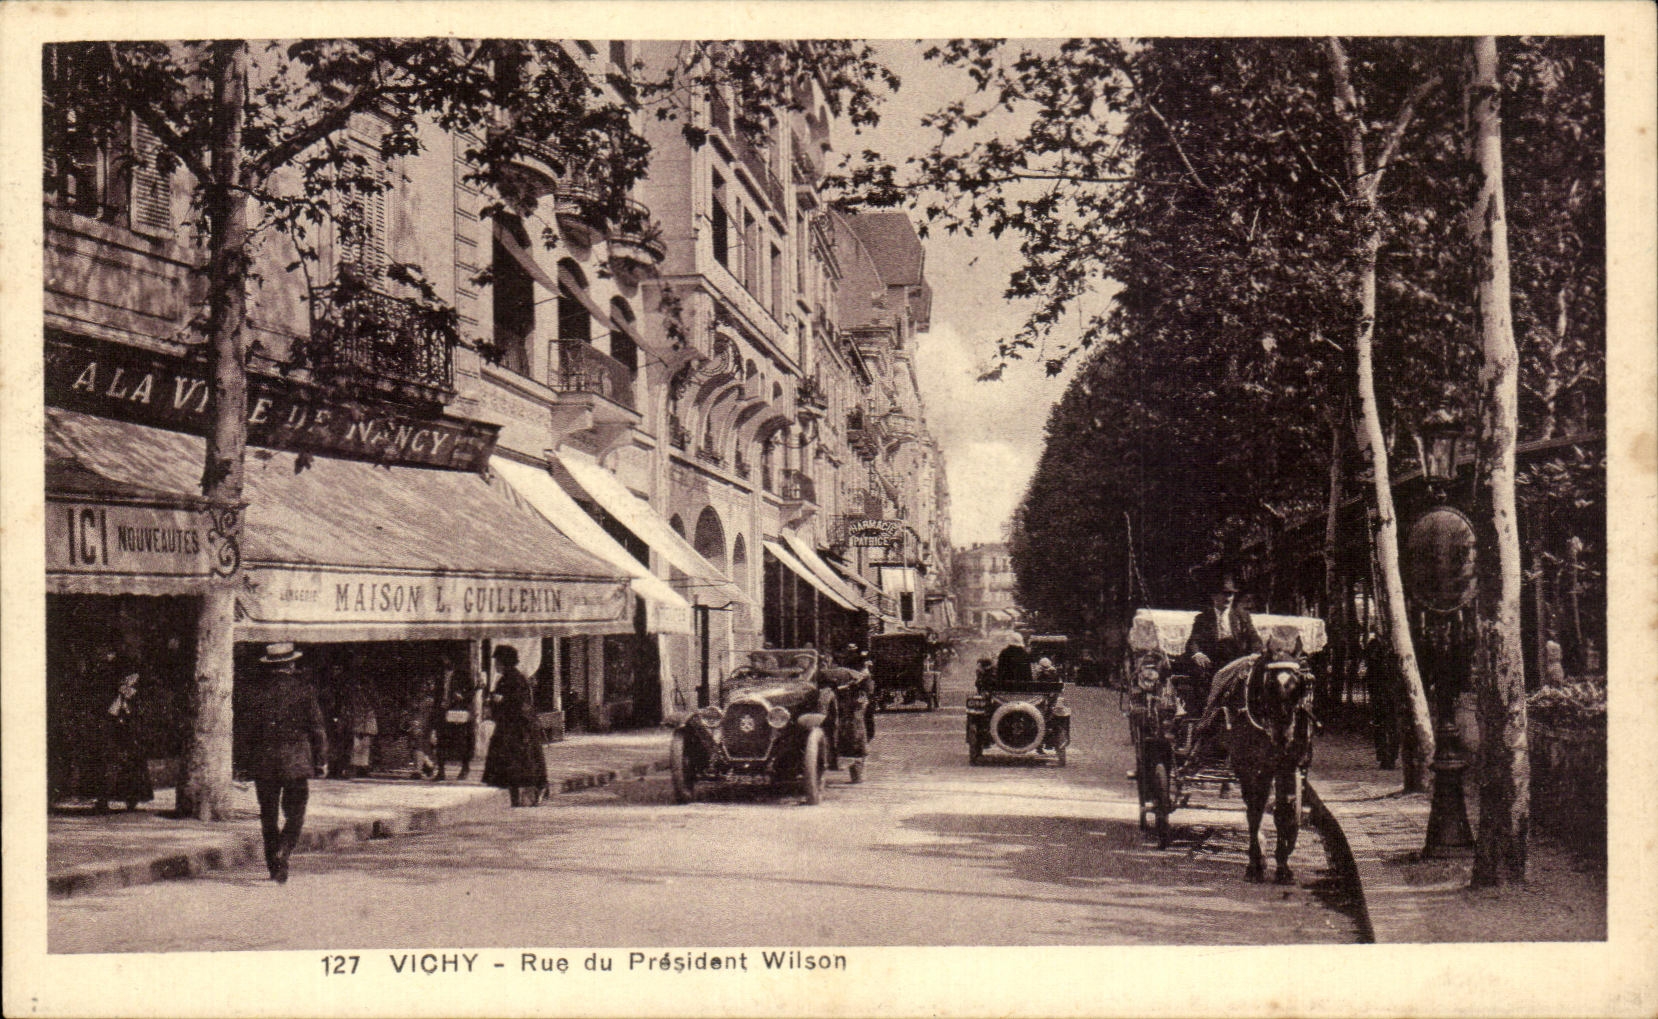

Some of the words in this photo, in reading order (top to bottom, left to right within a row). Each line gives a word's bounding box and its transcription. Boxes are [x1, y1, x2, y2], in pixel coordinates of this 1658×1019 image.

[72, 362, 97, 392] A
[105, 368, 153, 404] LA
[174, 376, 273, 424] VIE
[345, 421, 449, 455] NANCY
[67, 508, 108, 566] ICI
[335, 583, 422, 613] MAISON
[463, 586, 562, 613] GUILLEMIN
